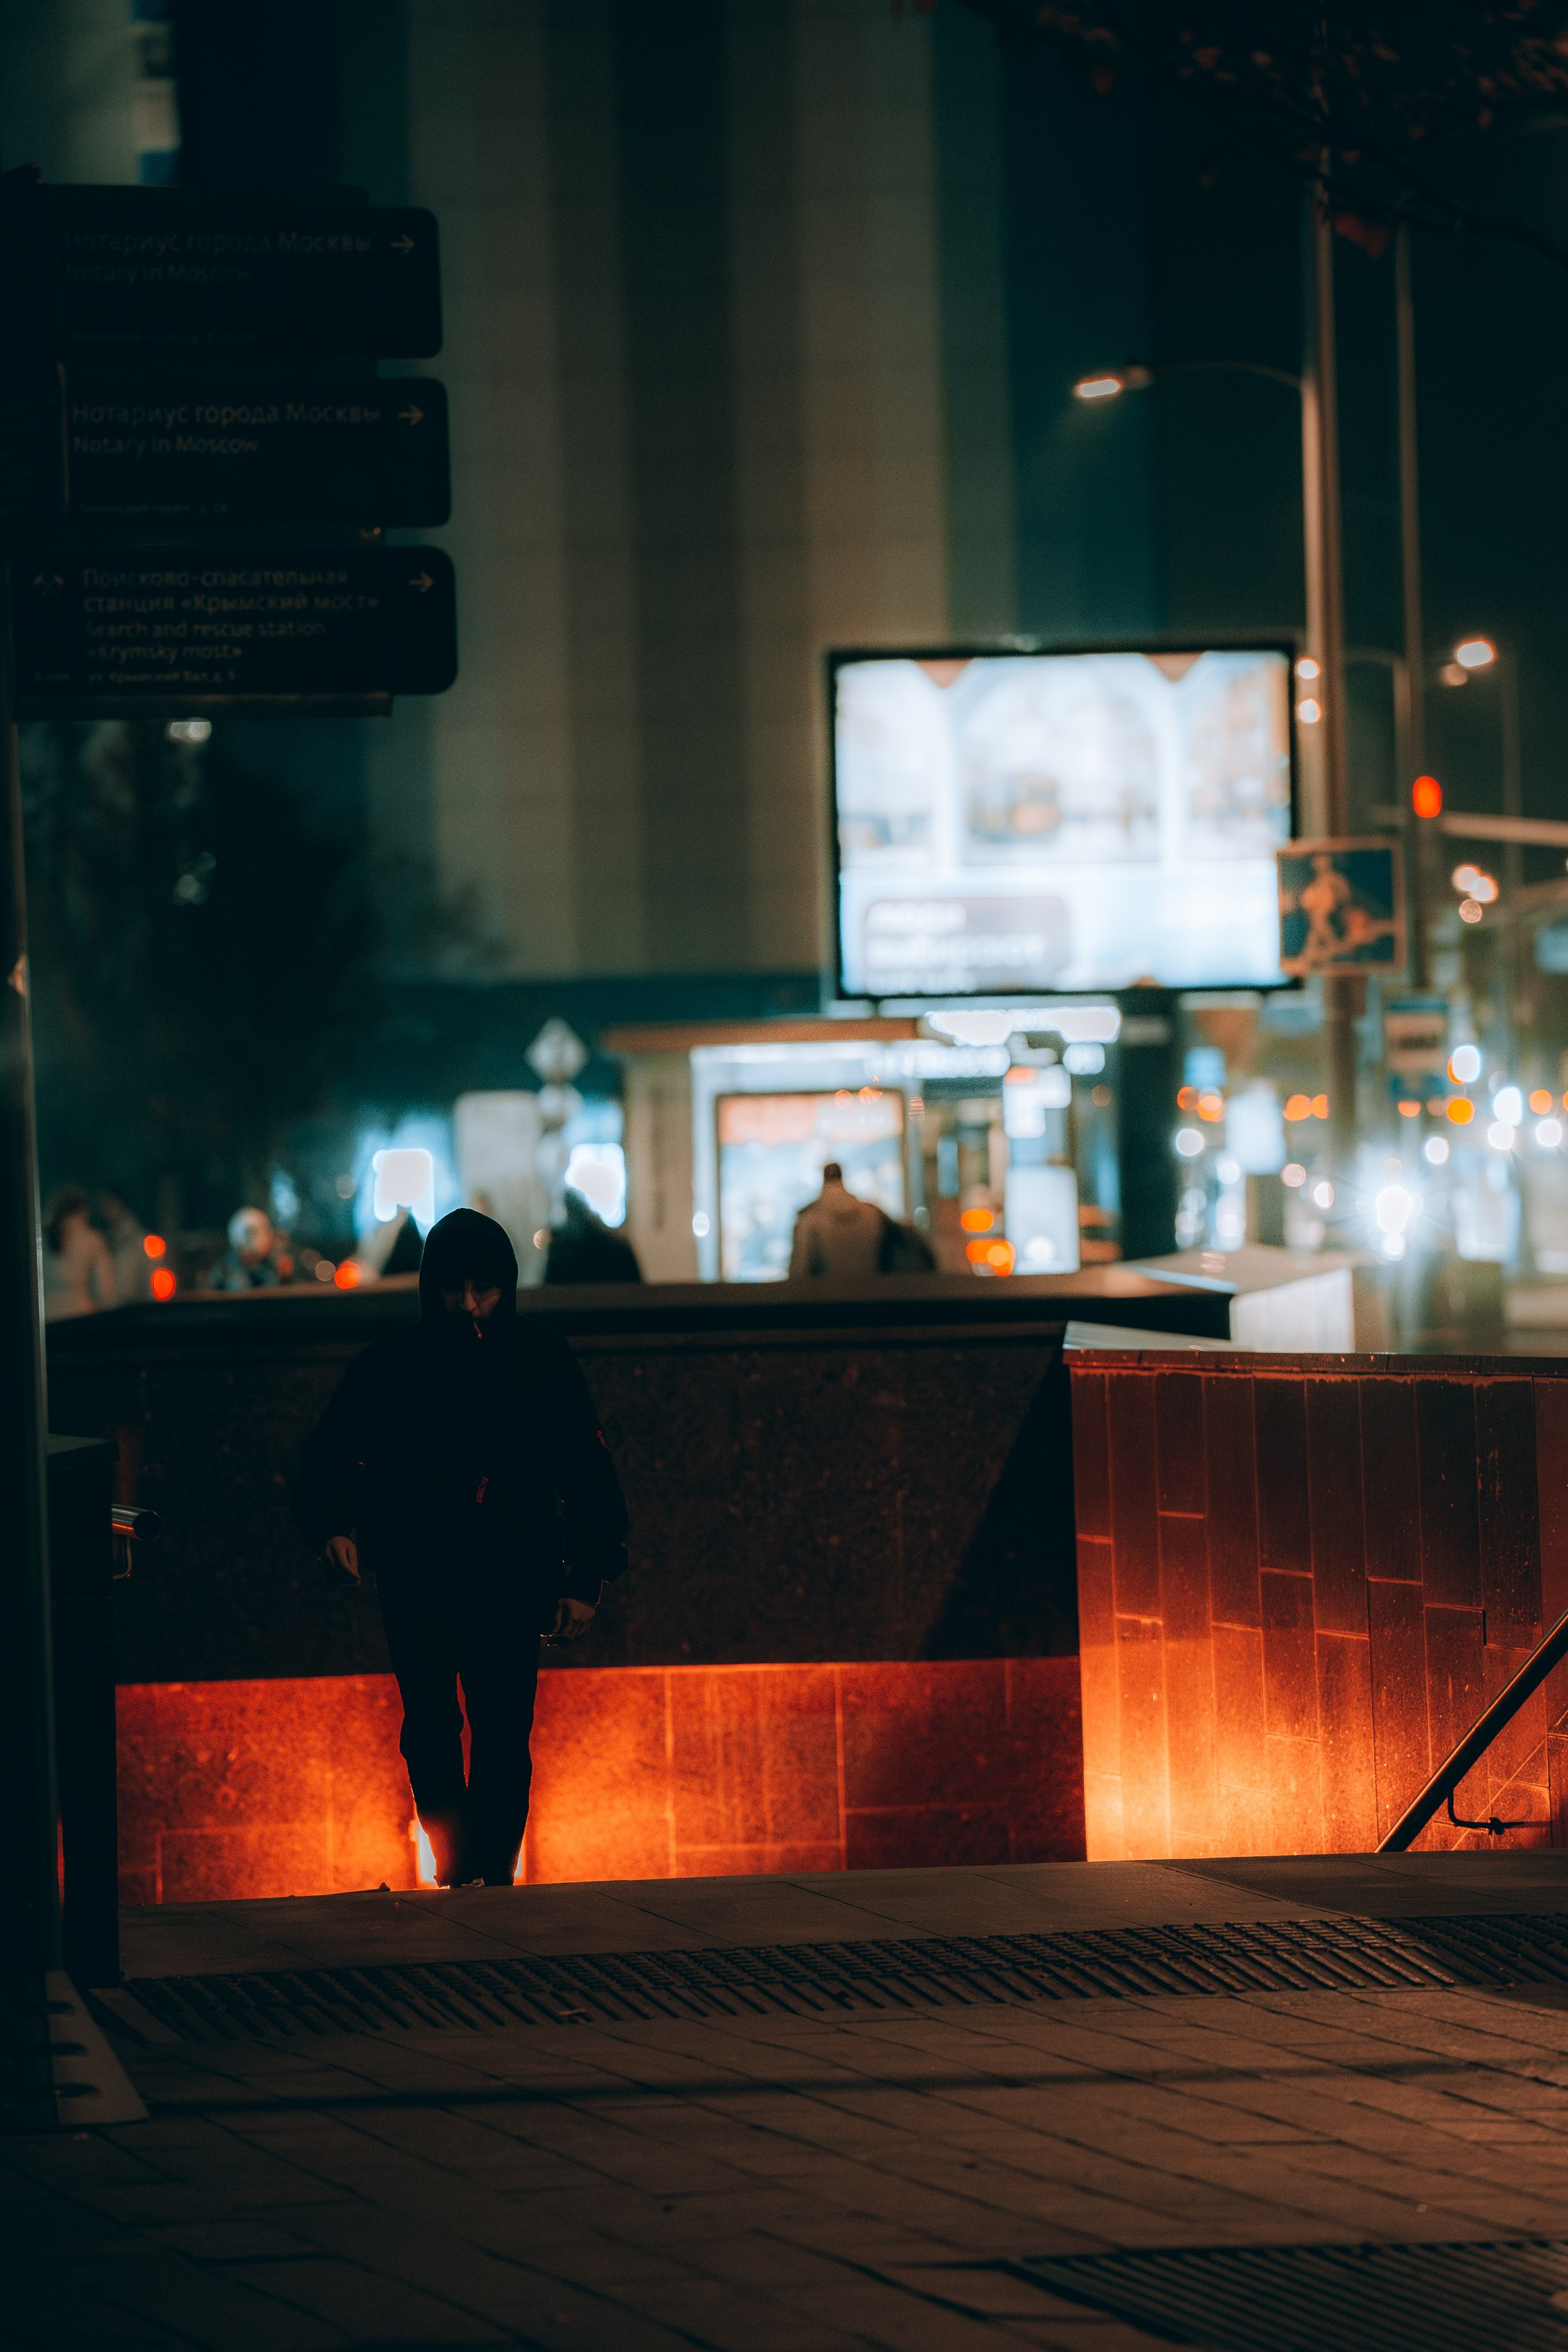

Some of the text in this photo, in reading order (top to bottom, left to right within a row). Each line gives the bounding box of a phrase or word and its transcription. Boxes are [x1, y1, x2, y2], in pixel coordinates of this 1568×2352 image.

[278, 230, 372, 253] Москвы
[73, 402, 382, 429] Нотариус города Москвы
[73, 435, 260, 458] Notary in Moscow
[83, 568, 349, 587] Поисково-спасательная
[83, 595, 175, 614] станция
[86, 619, 327, 638] Search and rescue station
